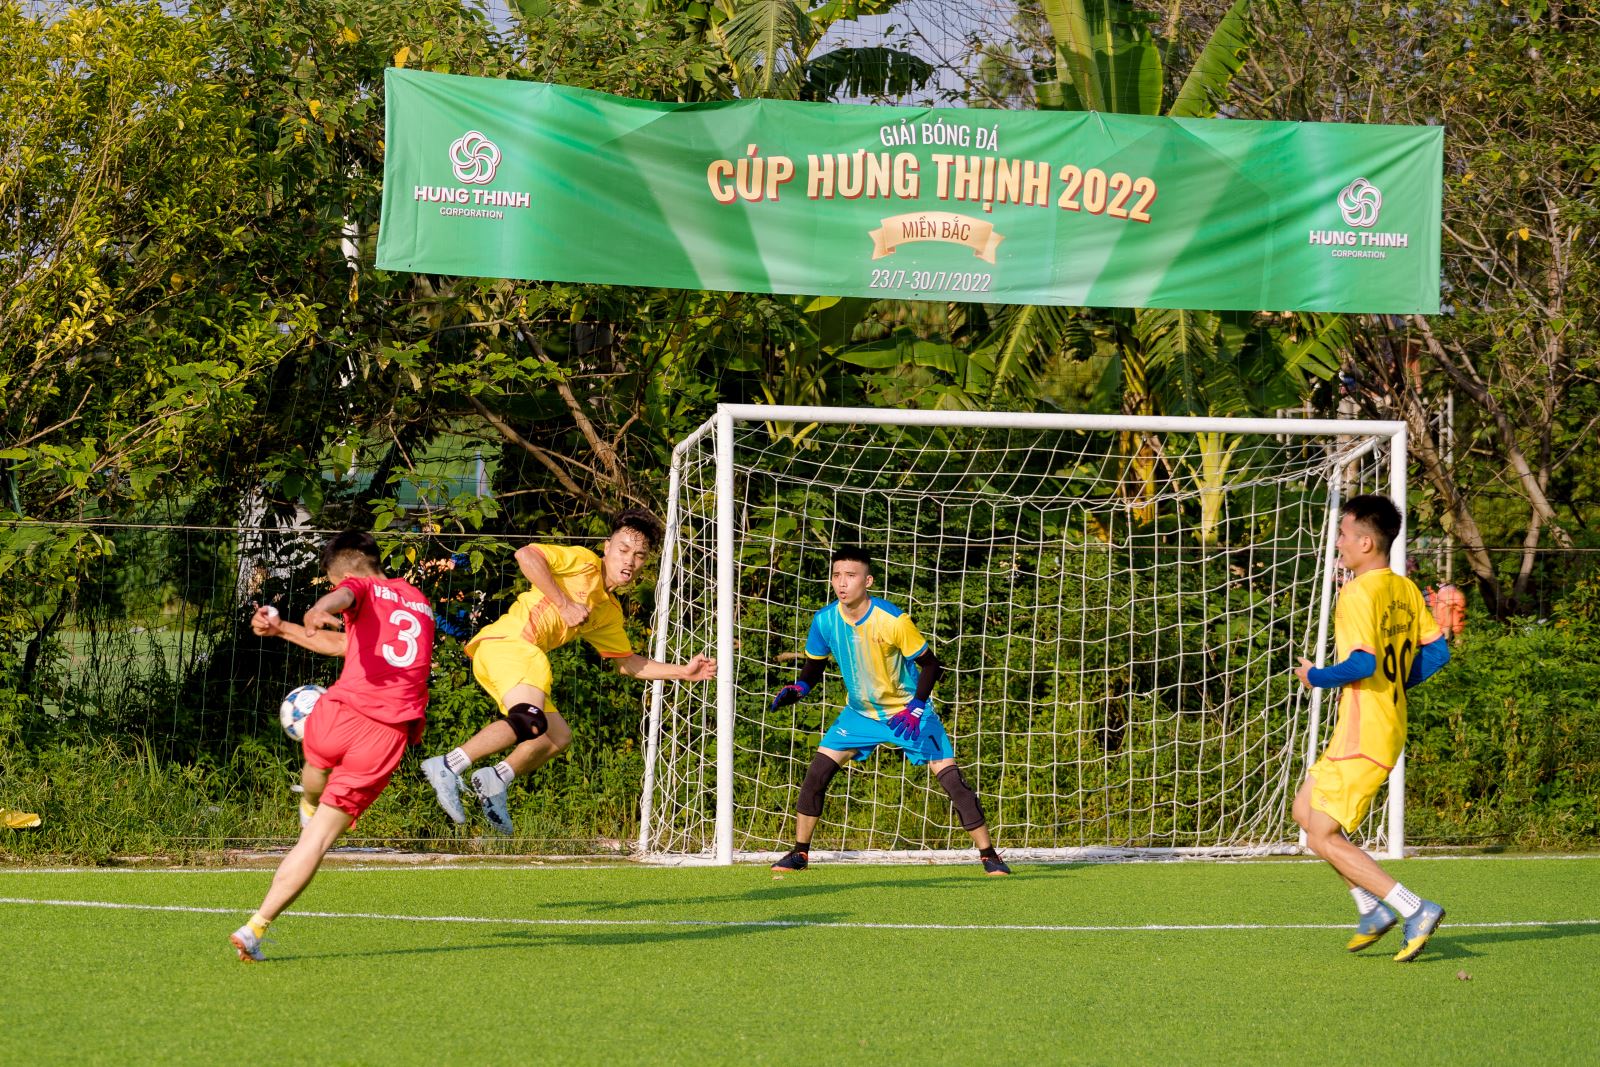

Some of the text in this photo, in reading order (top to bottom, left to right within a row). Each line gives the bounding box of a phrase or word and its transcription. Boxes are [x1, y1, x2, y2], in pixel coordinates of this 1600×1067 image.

[880, 117, 999, 152] GIẢI BÓNG ĐÁ
[707, 144, 1158, 224] CÚP HƯNG THỊNH 2022
[414, 186, 530, 208] HUNG THINH
[440, 207, 503, 219] CORPORATION
[902, 215, 971, 241] MIỀN BẮC
[1309, 230, 1408, 248] HUNG THINH
[1332, 250, 1386, 259] CORPORATION
[869, 268, 992, 293] 23/7-30/7/2022
[382, 609, 422, 668] 3
